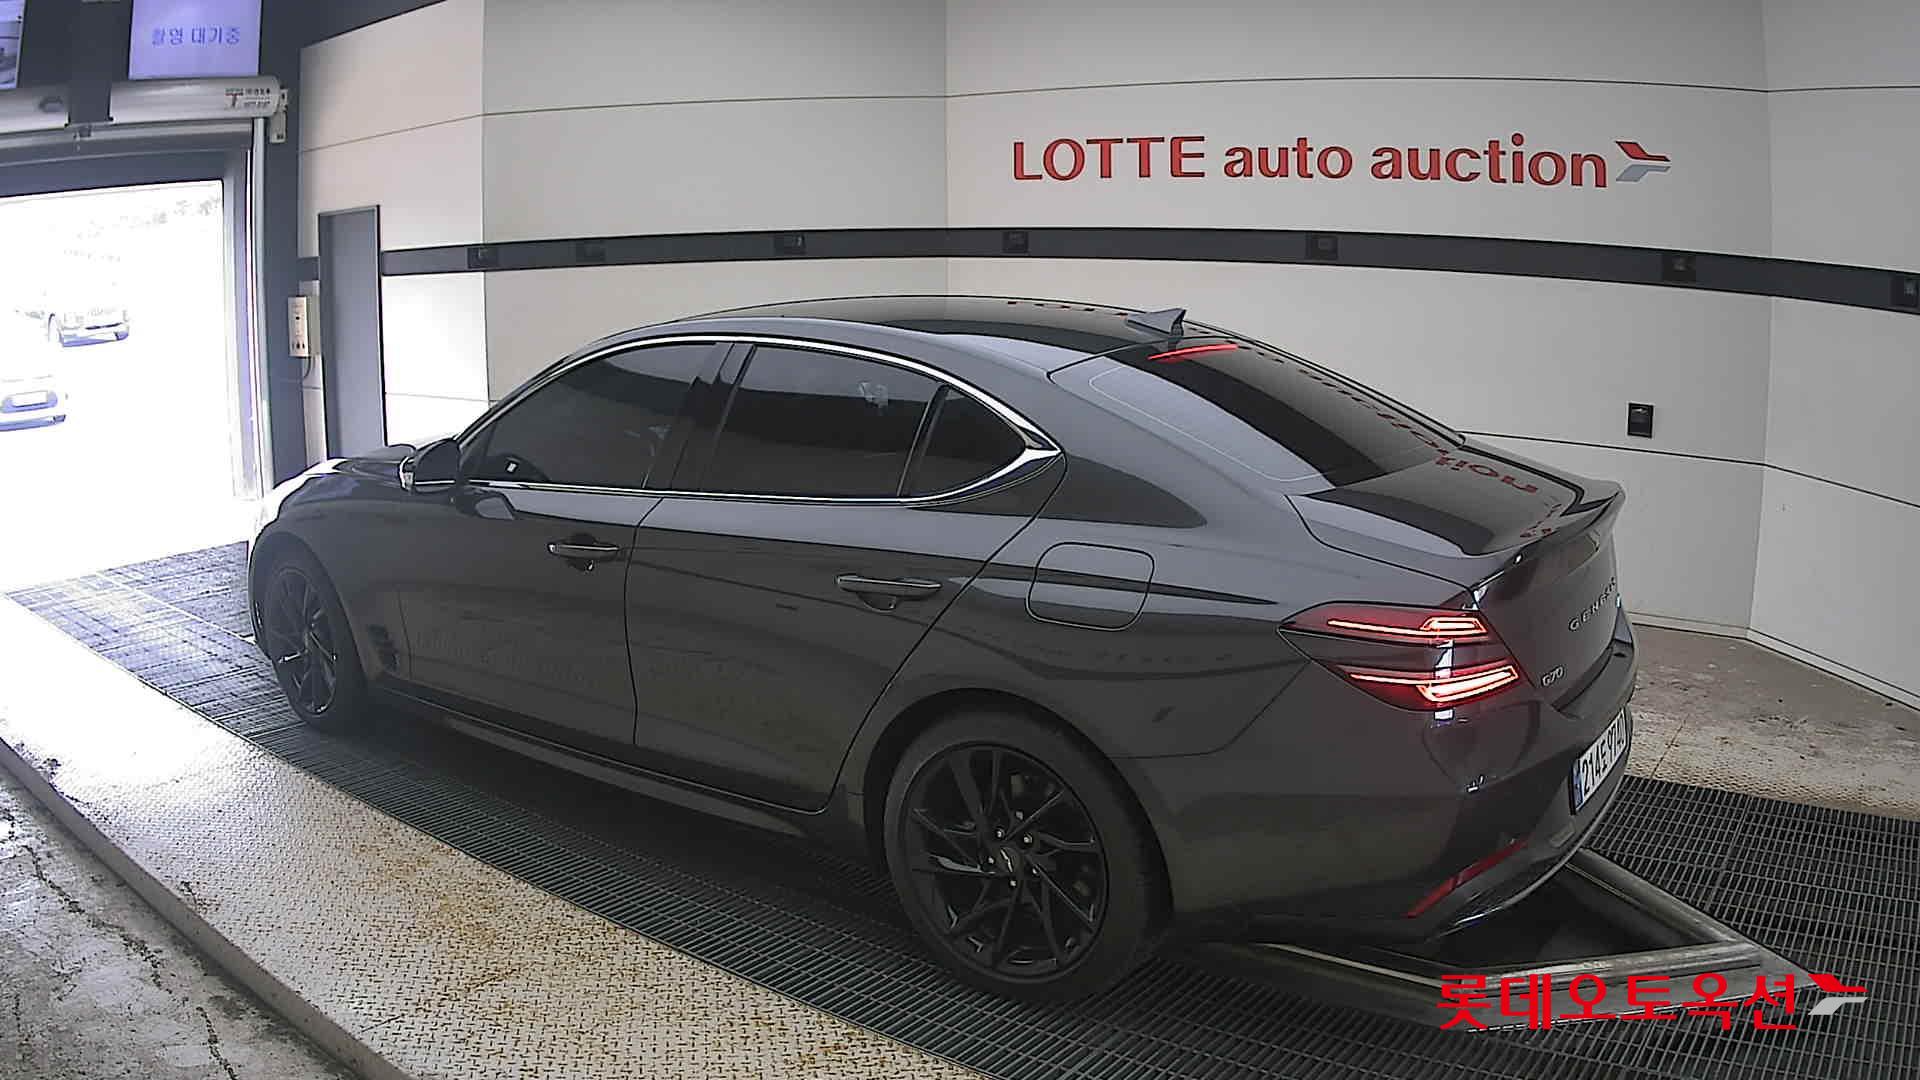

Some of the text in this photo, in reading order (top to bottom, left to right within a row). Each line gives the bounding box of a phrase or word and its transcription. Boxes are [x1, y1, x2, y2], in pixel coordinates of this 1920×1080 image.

[191, 26, 241, 46] 대기중
[1013, 132, 1608, 189] LOTTE auto auction
[1568, 576, 1616, 632] GENE
[1541, 665, 1565, 687] G70
